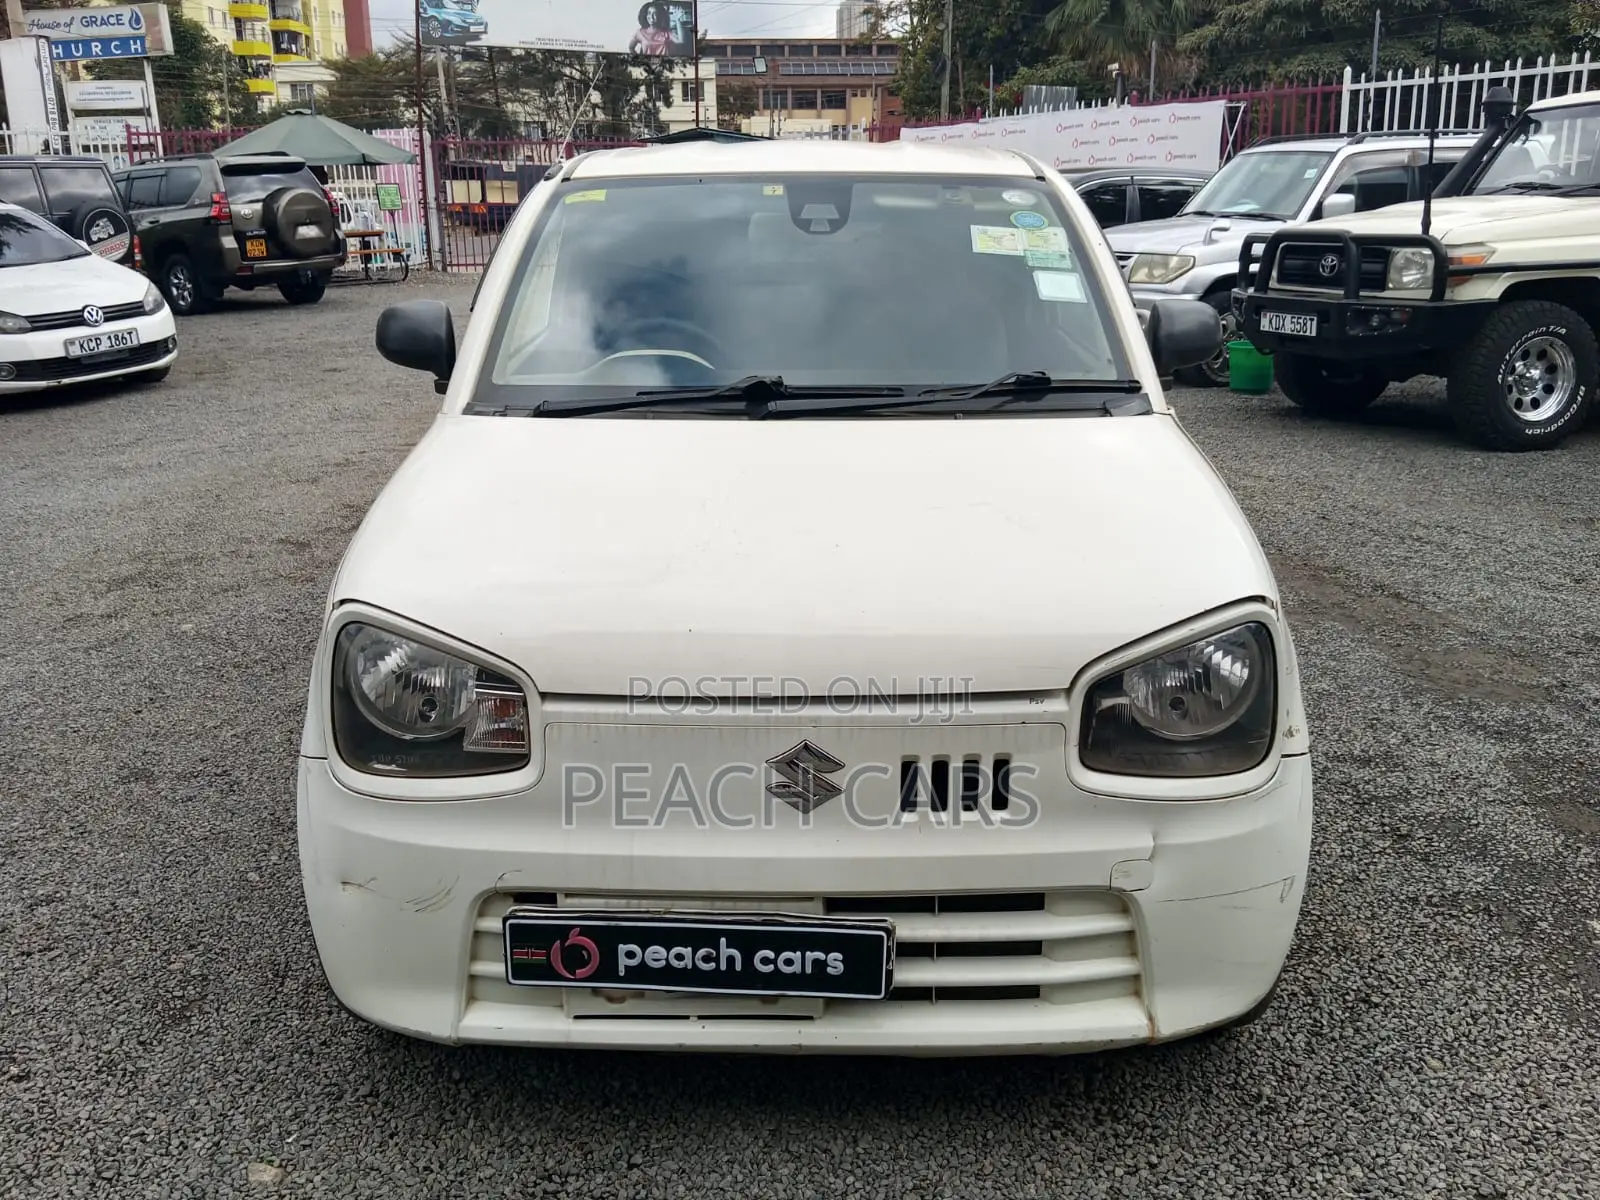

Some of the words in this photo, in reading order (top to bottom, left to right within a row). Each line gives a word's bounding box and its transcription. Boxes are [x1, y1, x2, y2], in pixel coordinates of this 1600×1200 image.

[27, 19, 62, 32] House
[63, 16, 75, 33] of
[80, 14, 125, 28] GRACE
[51, 39, 142, 58] HURCH
[99, 240, 126, 257] PRADO
[1269, 314, 1287, 331] KDX
[1290, 316, 1315, 335] 558T
[1548, 325, 1567, 334] T/A
[79, 337, 102, 354] KCP
[108, 331, 134, 349] 186T
[1525, 385, 1586, 435] BFGoodrich
[618, 937, 742, 977] peach
[753, 948, 845, 976] cars
